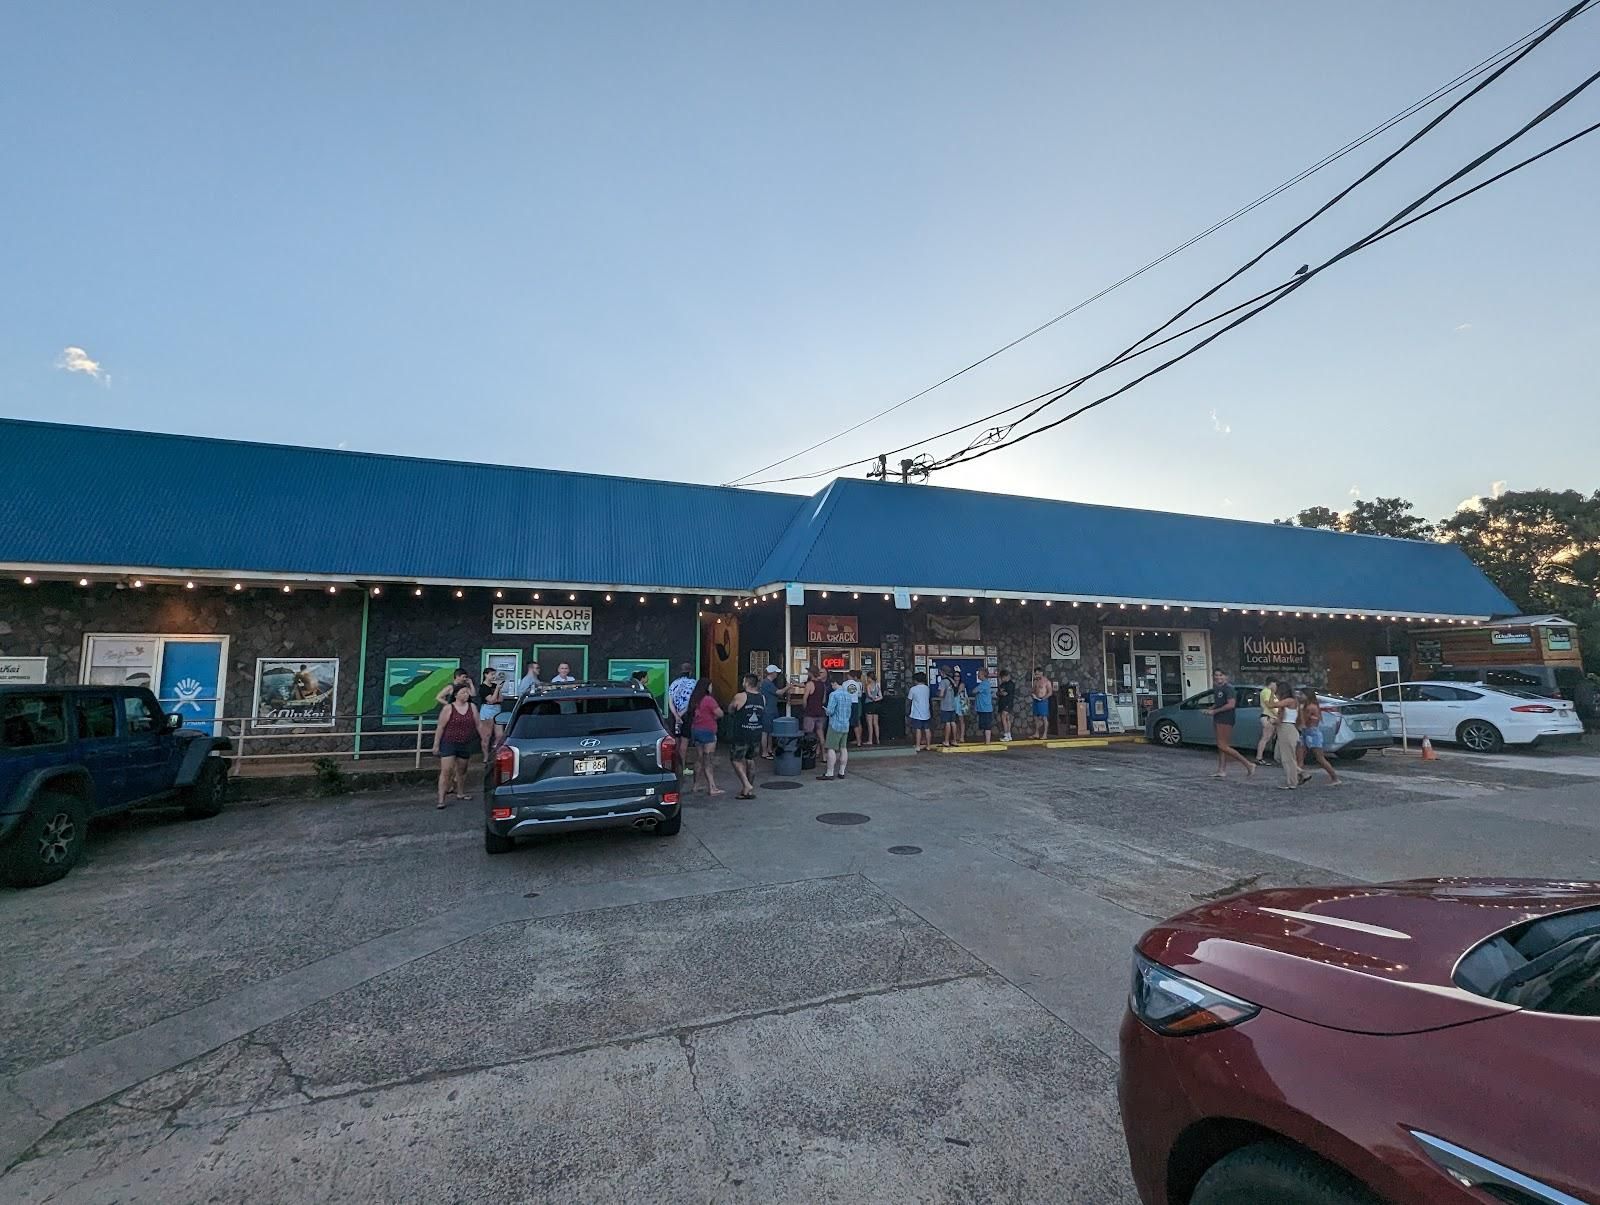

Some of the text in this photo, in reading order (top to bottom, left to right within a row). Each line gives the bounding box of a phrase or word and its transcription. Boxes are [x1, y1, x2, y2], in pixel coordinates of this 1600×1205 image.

[494, 608, 543, 619] GREEN
[810, 631, 822, 641] DA
[823, 658, 845, 668] OPEN
[1246, 654, 1304, 664] Local Market
